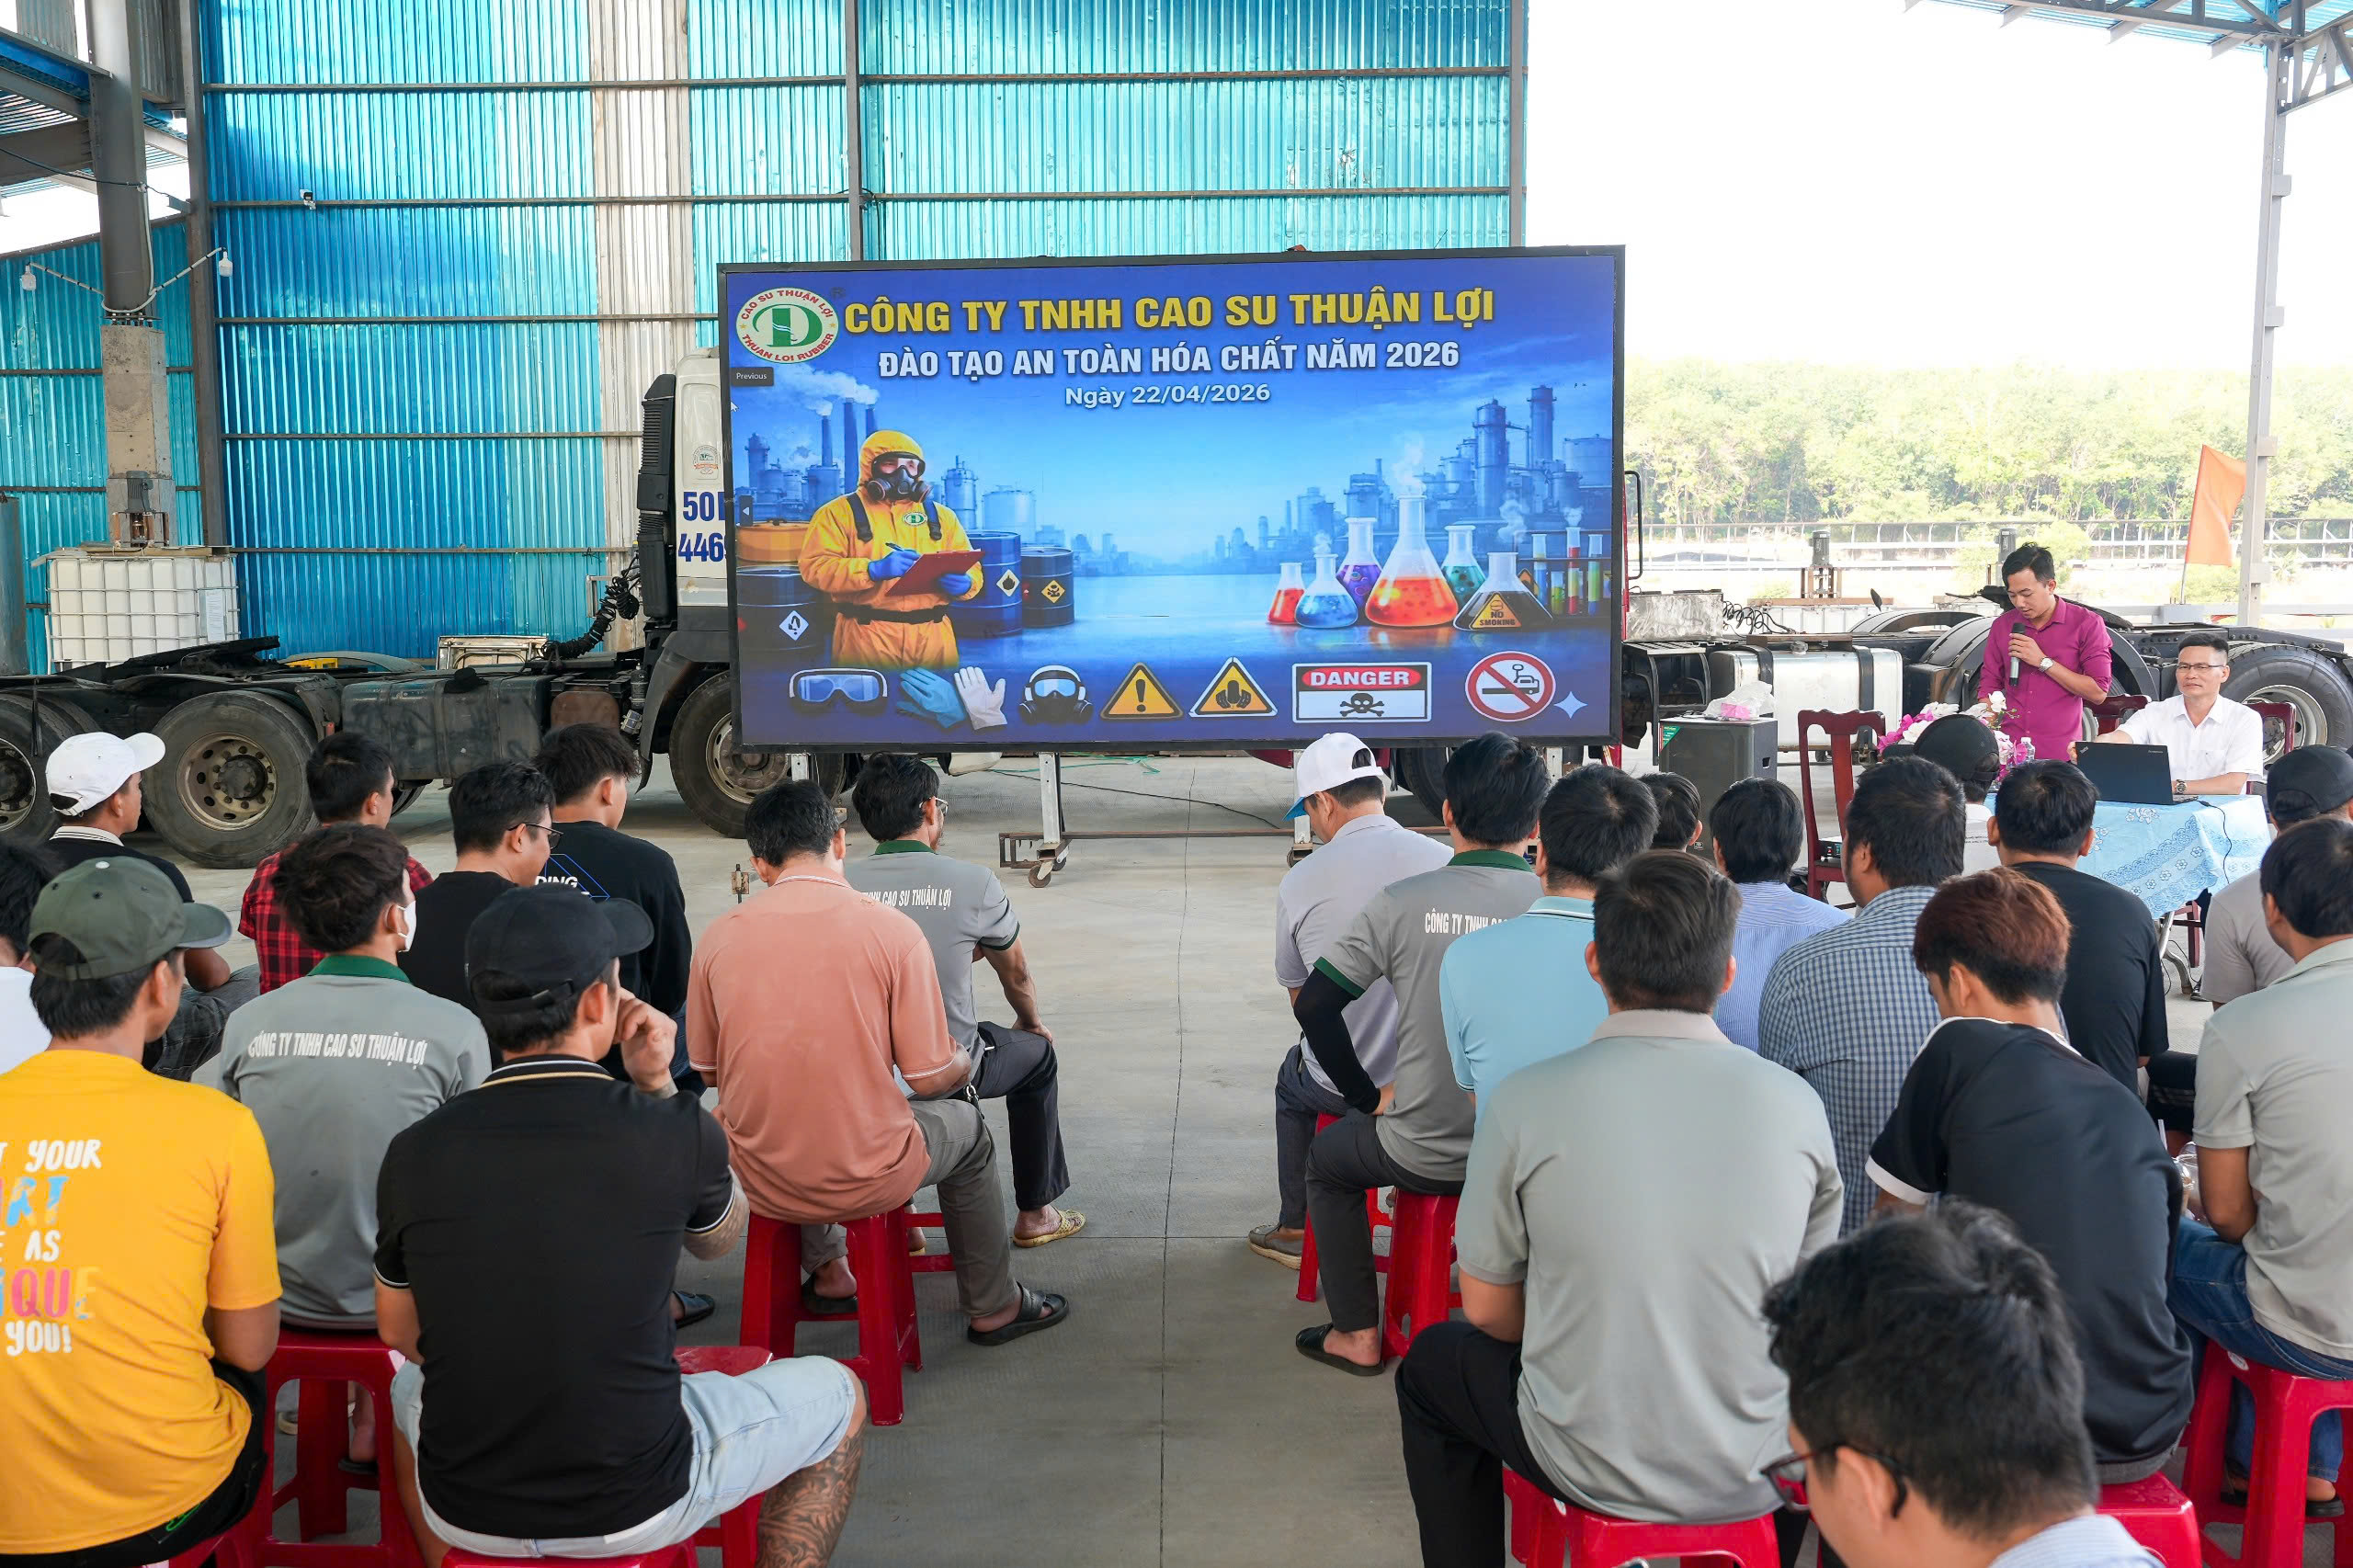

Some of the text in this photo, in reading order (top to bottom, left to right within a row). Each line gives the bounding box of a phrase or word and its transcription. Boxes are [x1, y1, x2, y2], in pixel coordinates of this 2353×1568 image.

[741, 301, 758, 320] CAO
[758, 291, 774, 302] SU
[845, 285, 1494, 334] CÔNG TY TNHH CAO SU THUẬN LỢI
[742, 333, 835, 362] THUAN LOI RUBBER
[879, 335, 1460, 381] ĐÀO TẠO AN TOÀN HÓA CHẤT NĂM 2026
[736, 372, 767, 381] Previous
[1065, 383, 1271, 409] Ngày 22/04/2026
[678, 532, 727, 562] 446
[1310, 671, 1410, 687] DANGER
[882, 890, 898, 907] CAO
[899, 889, 911, 907] SU
[912, 884, 938, 910] THUẬN
[938, 888, 952, 911] LỢI
[1425, 907, 1449, 934] CÔNG
[1451, 913, 1463, 935] TY
[247, 1030, 428, 1070] CÔNG TY TNHH CAO SU THUẬN LỢI
[25, 1139, 102, 1173] YOUR
[0, 1176, 70, 1227] RT
[24, 1230, 62, 1263] AS
[6, 1320, 73, 1357] YOU!
